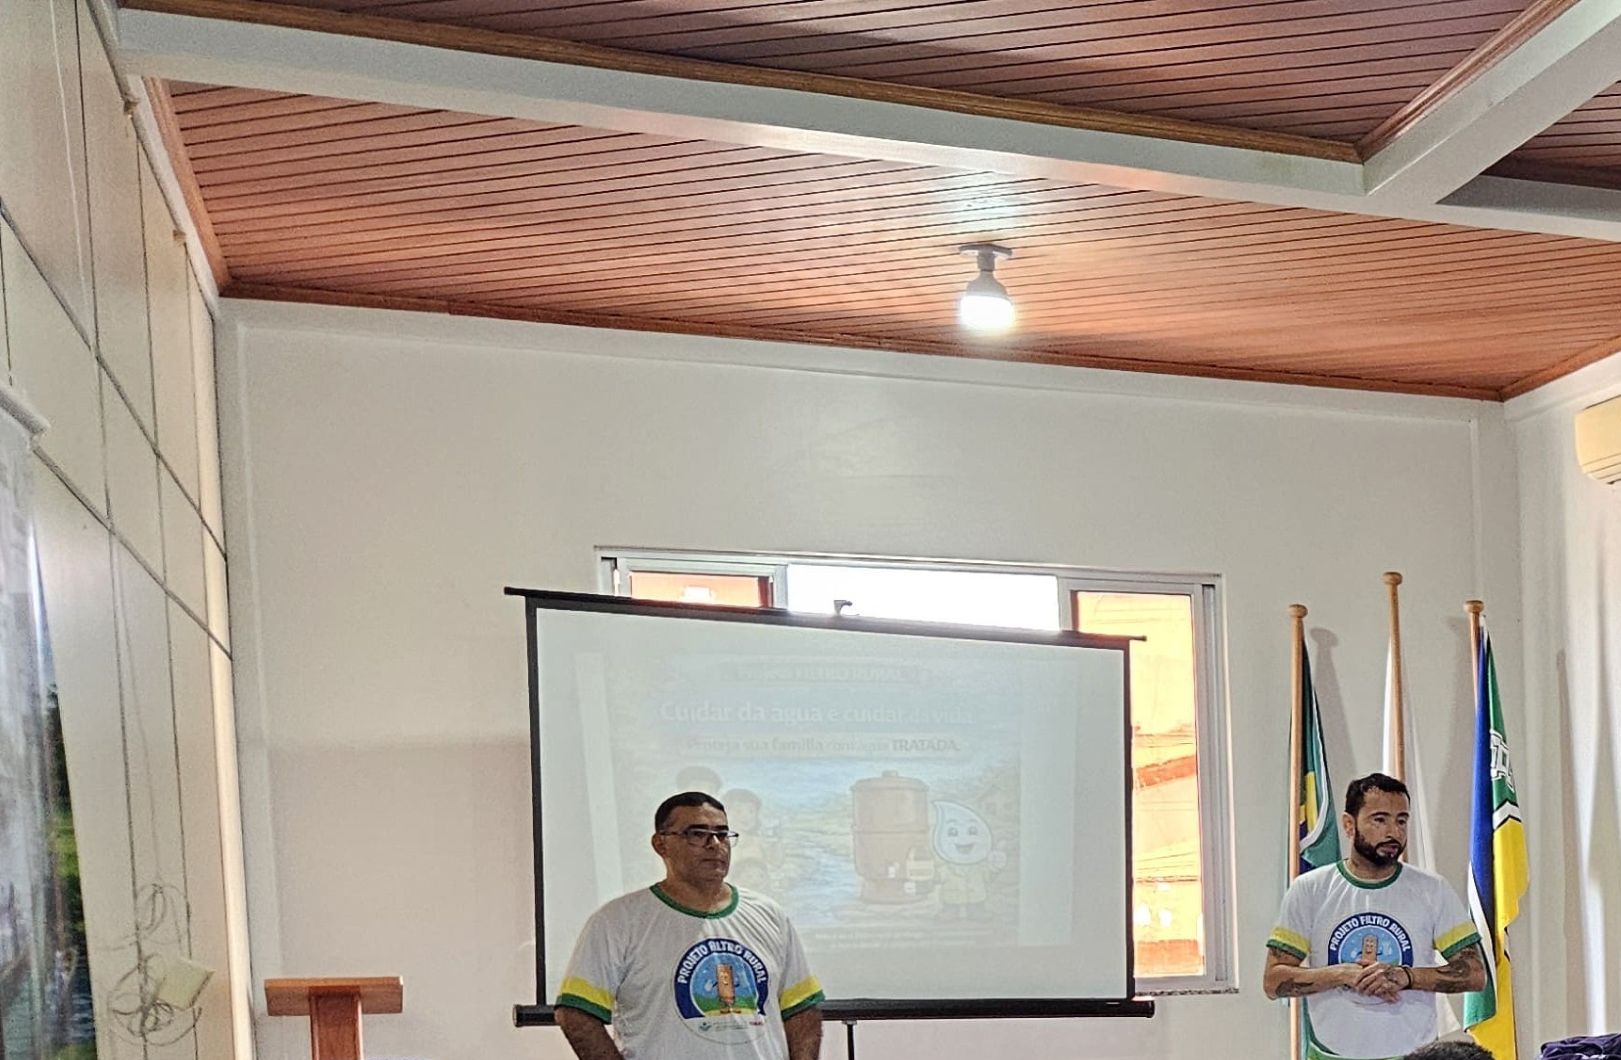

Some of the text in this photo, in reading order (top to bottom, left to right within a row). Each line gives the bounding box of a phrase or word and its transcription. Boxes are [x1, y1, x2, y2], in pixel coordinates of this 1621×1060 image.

[738, 702, 765, 722] da
[1330, 915, 1411, 952] PROJETO FILTRO RURAL
